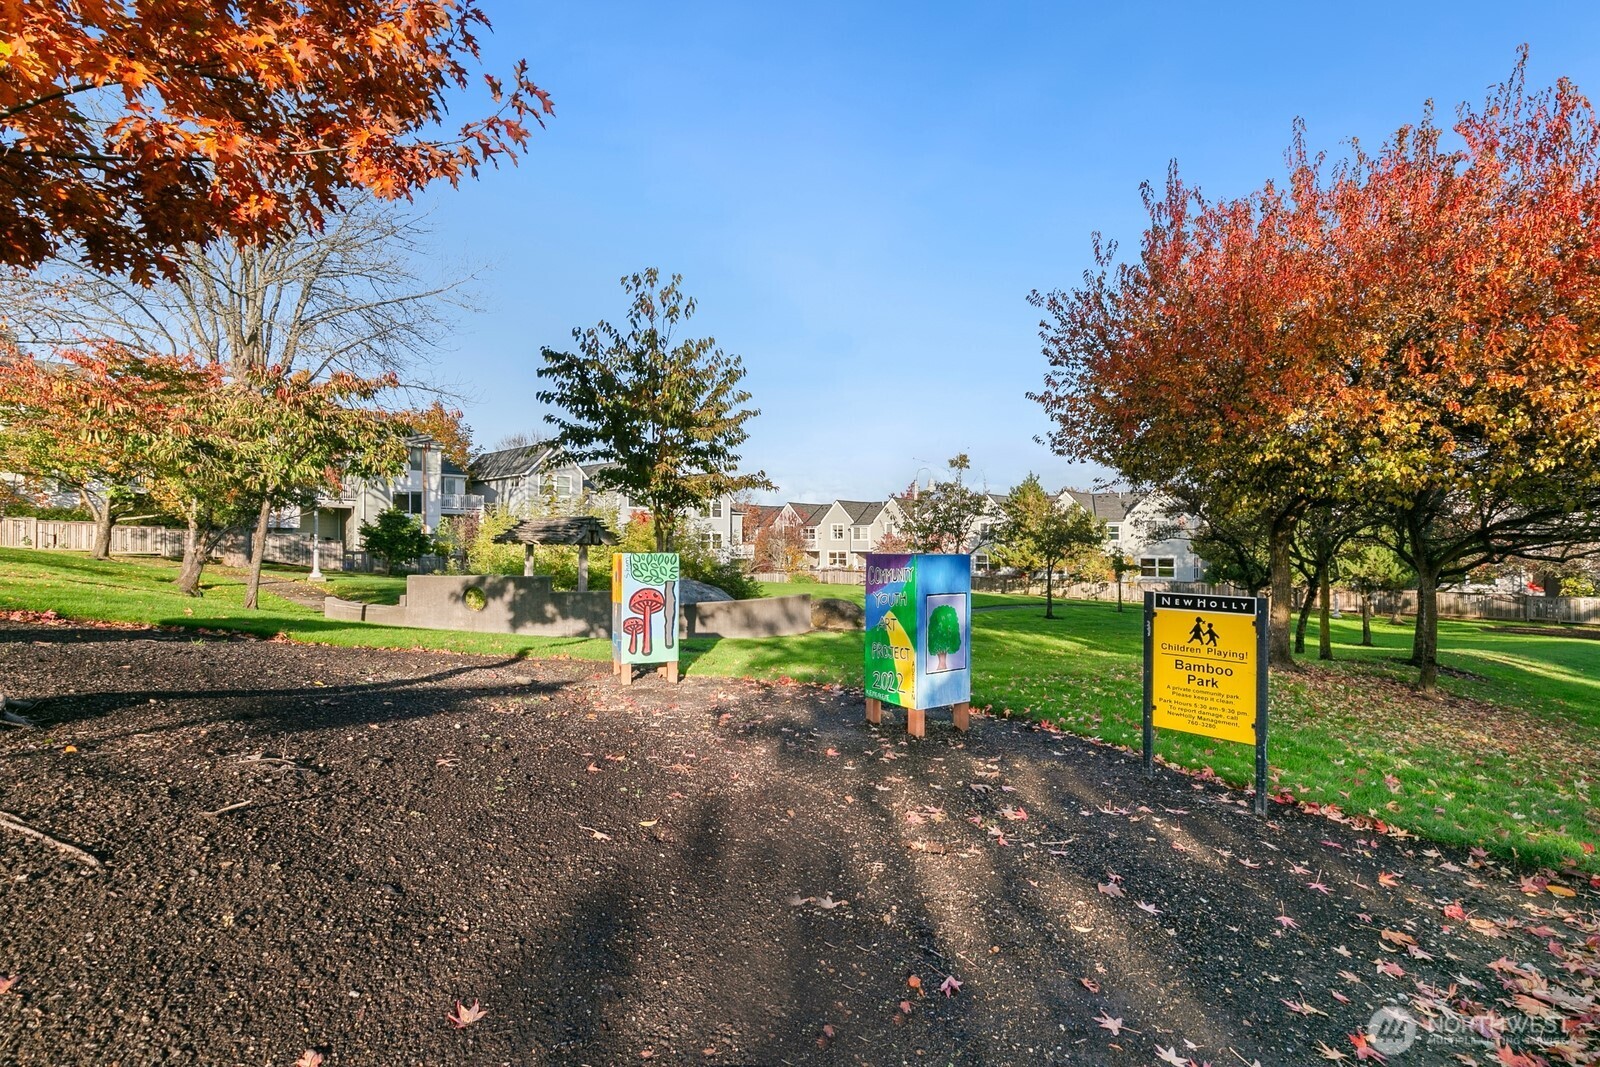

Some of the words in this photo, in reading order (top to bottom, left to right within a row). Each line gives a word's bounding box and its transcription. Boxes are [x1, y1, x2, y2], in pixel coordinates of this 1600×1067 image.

[868, 566, 914, 585] COMMUNITY
[873, 591, 907, 608] YOUTH
[877, 616, 897, 631] ART
[871, 642, 910, 660] PROJECT
[1161, 642, 1201, 654] Children
[1207, 647, 1248, 660] Playing!
[1174, 659, 1234, 677] Bamboo
[872, 670, 906, 694] 2022
[1187, 674, 1219, 689] Park
[1172, 685, 1192, 694] private
[1192, 688, 1225, 698] community
[1193, 694, 1209, 702] keep
[1216, 697, 1236, 705] clean.
[1166, 710, 1195, 720] NewHolly
[1177, 706, 1197, 714] report
[1197, 708, 1225, 719] damage,
